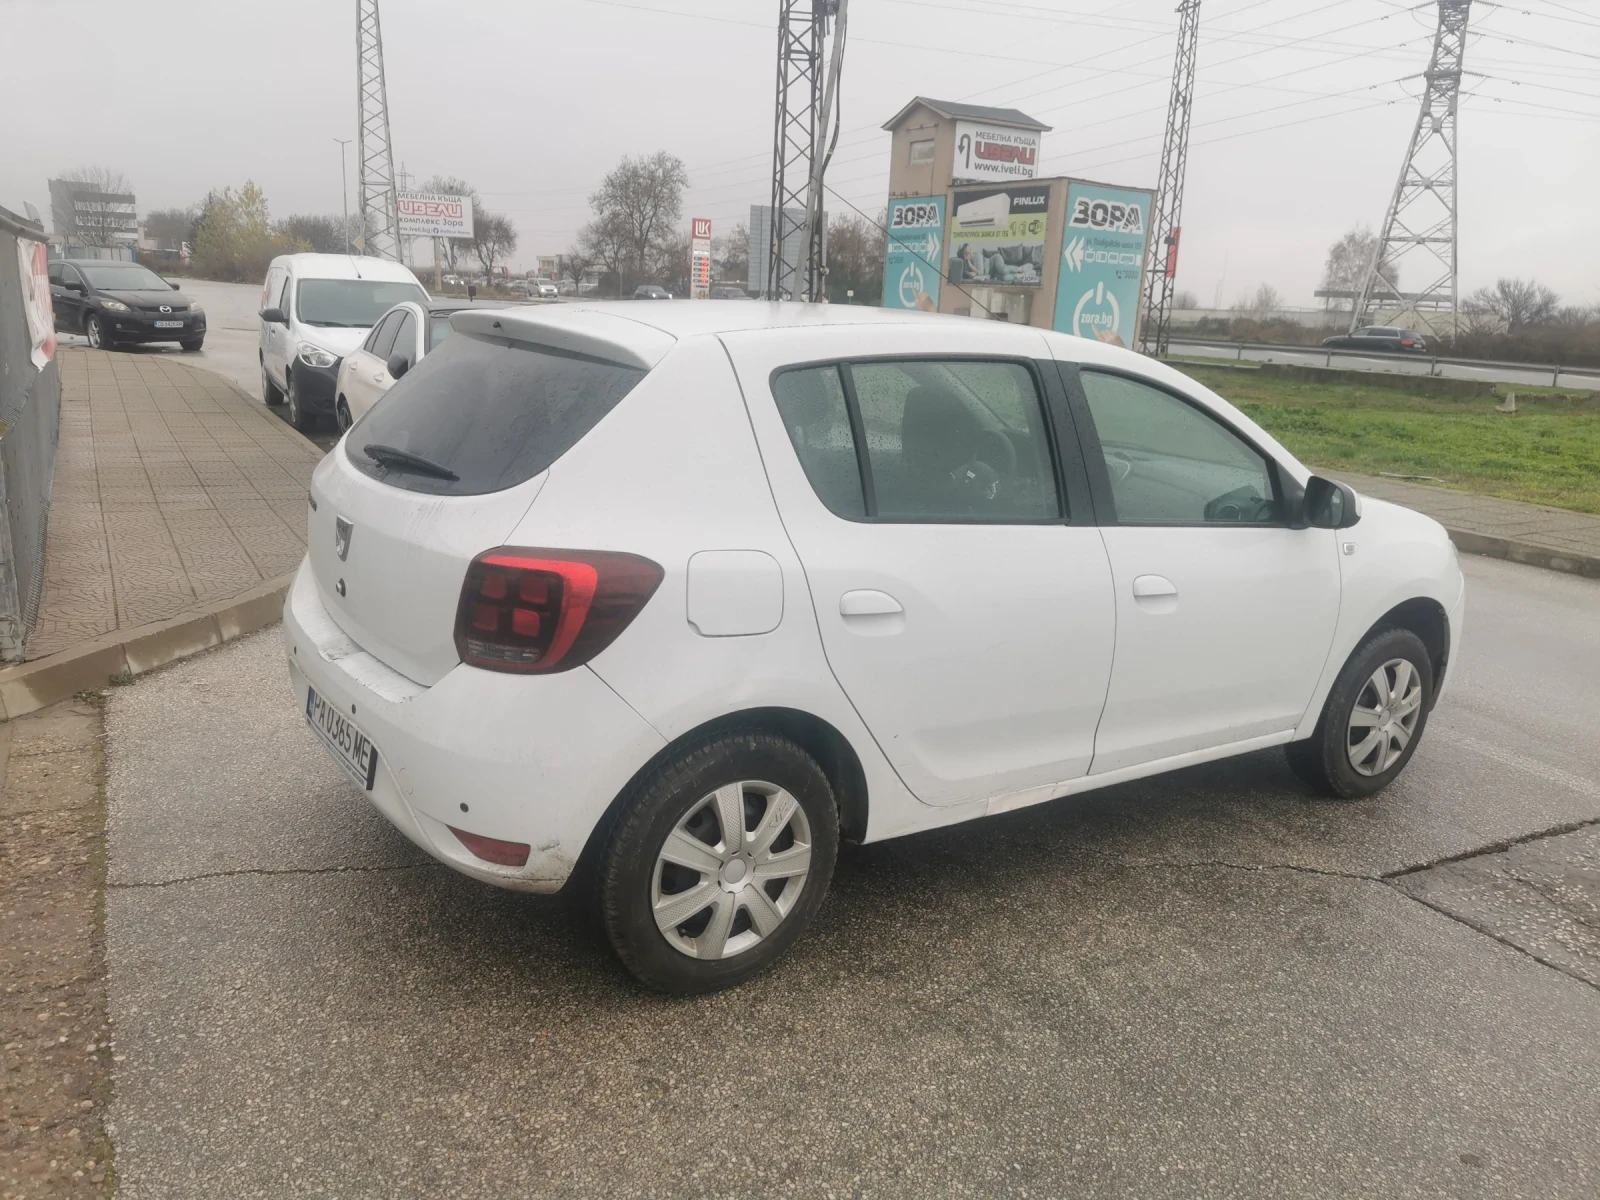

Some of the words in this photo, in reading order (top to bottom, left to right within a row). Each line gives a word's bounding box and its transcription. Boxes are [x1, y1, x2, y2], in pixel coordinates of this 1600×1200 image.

[975, 131, 1012, 143] МЕБЕЛНА
[1013, 136, 1036, 146] КЪЩА
[974, 162, 1033, 178] www.iveli.bg
[397, 192, 436, 201] МЕБЕЛНА
[437, 195, 461, 203] КЪЩА
[1013, 196, 1045, 206] FINLUX
[443, 218, 463, 227] Зора
[892, 203, 939, 228] ЗОРА
[1070, 198, 1142, 233] ЗОРА
[1081, 312, 1112, 328] zora.bg
[326, 706, 354, 753] 0365
[352, 730, 371, 773] ME
